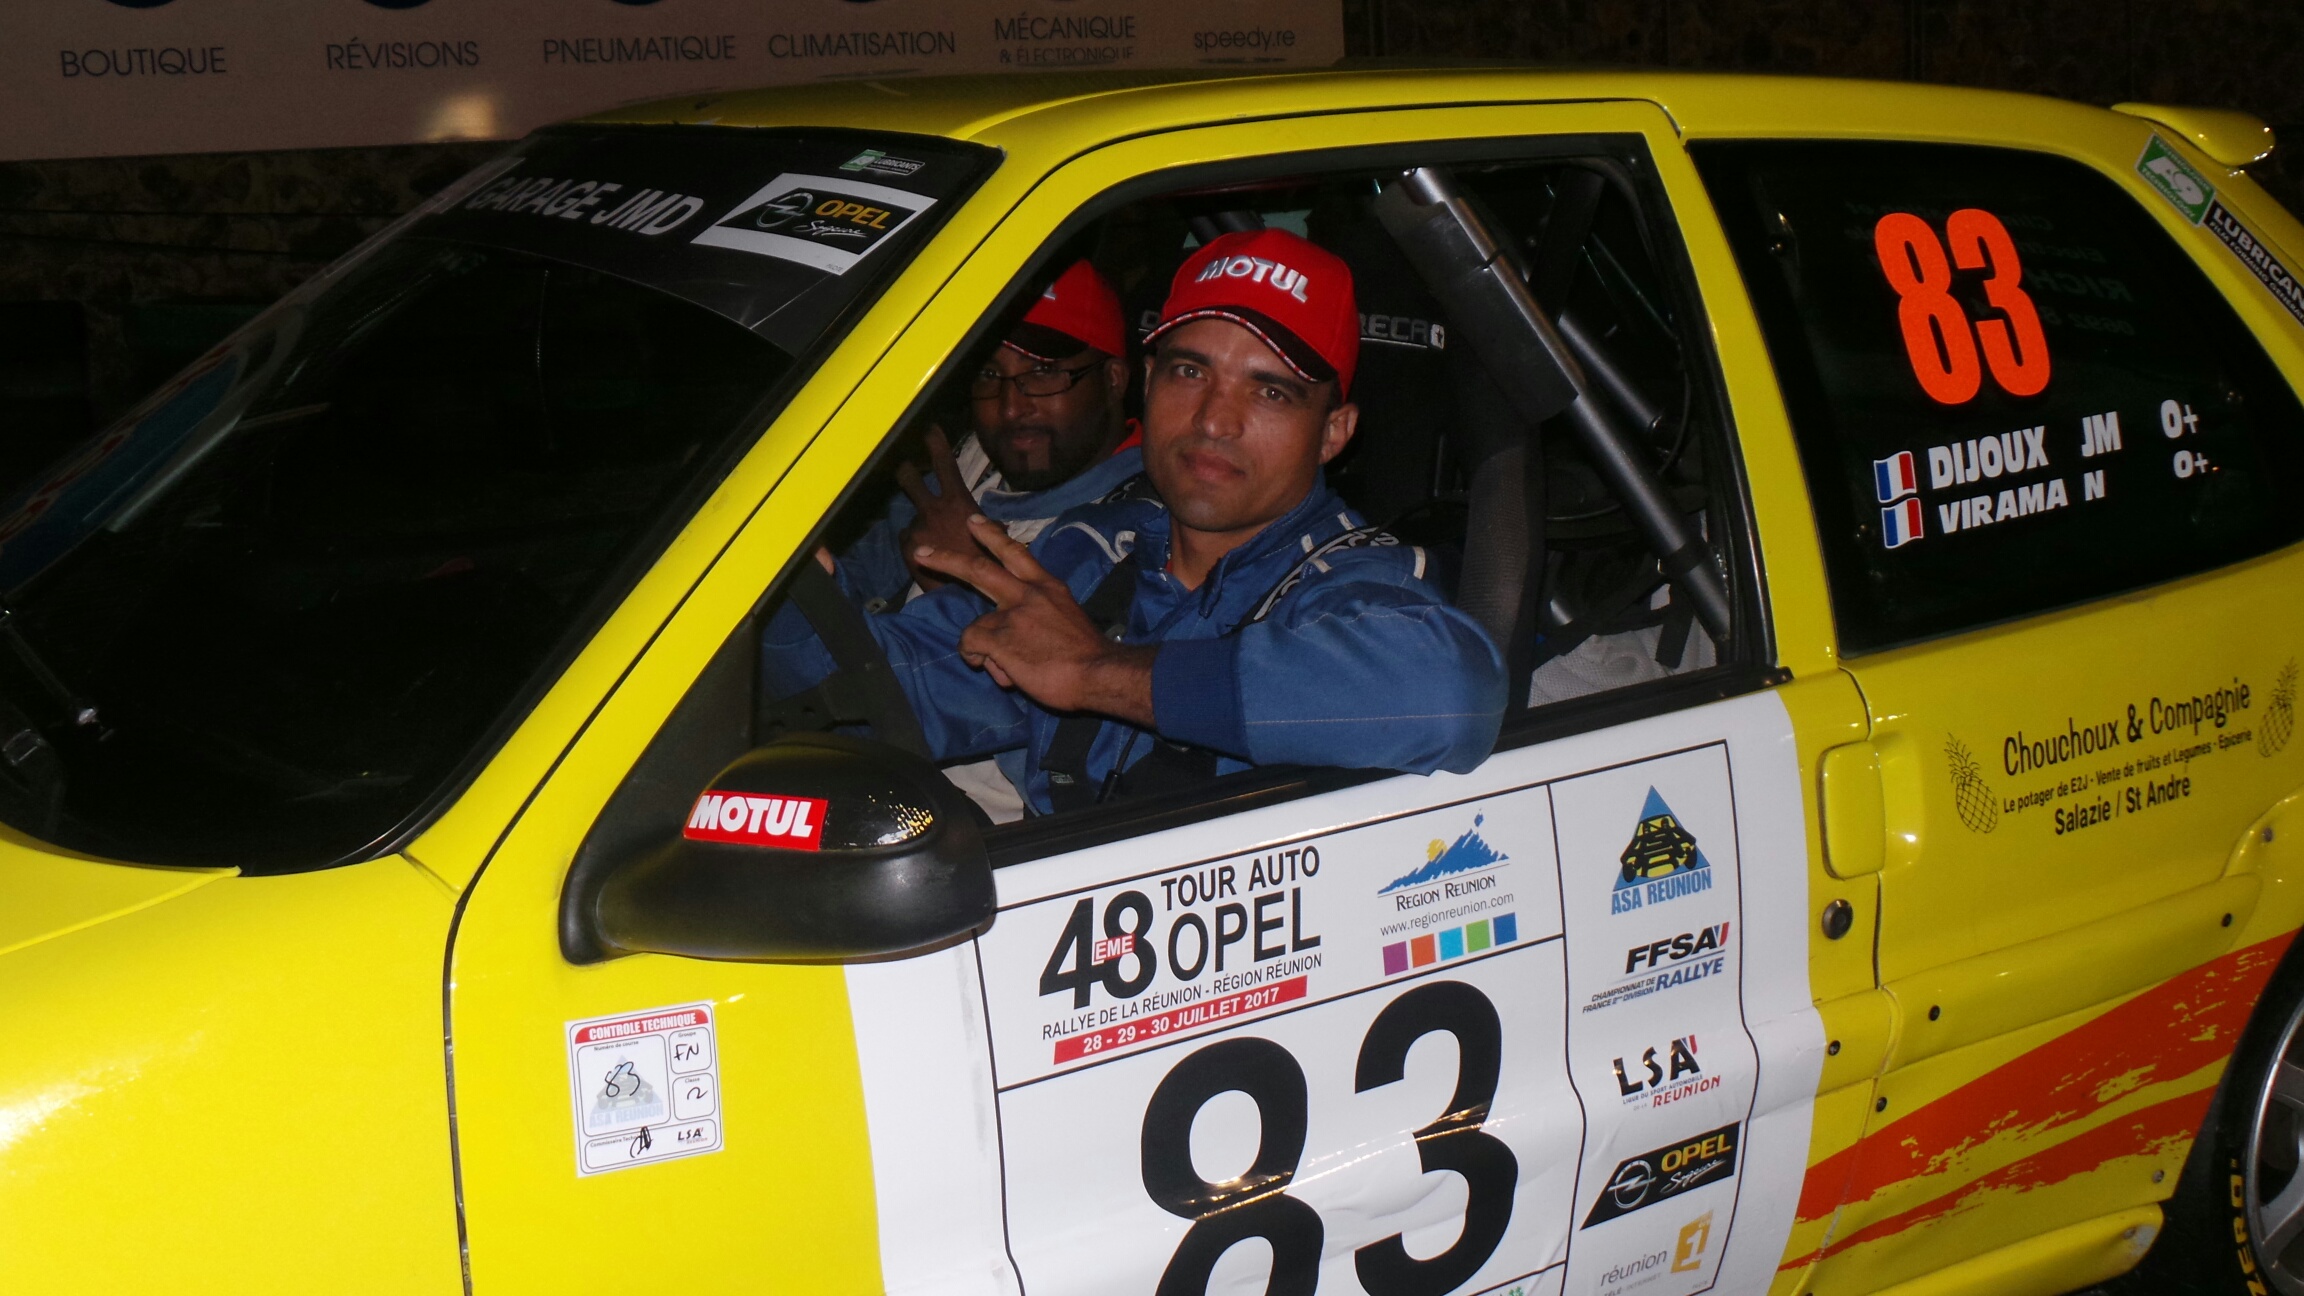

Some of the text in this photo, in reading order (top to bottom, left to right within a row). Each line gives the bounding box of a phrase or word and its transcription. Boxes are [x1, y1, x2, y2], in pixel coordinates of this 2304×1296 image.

[768, 31, 956, 58] CLIMATISATION
[994, 12, 1136, 41] MÉCANIQUE
[1194, 27, 1296, 52] speedy.re
[60, 47, 227, 77] BOUTIQUE
[326, 37, 480, 70] RÉVISIONS
[542, 35, 737, 65] PNEUMATIQUE
[466, 176, 705, 236] GARAGE JMD
[814, 199, 892, 229] OPEL
[1194, 254, 1309, 304] MOTUL
[1874, 208, 2051, 404] 83
[1928, 425, 2050, 489] DIJOUX
[2081, 411, 2122, 457] JM
[1938, 479, 2069, 533] VIRAMA
[2084, 470, 2106, 502] N
[2003, 677, 2251, 776] Chouchoux & Compagnie
[2003, 797, 2017, 814] Le
[2017, 785, 2055, 814] potager
[2057, 780, 2069, 797] de
[2095, 767, 2122, 787] Vente
[2123, 762, 2134, 778] de
[2136, 755, 2162, 775] fruits
[2163, 752, 2172, 768] et
[688, 795, 813, 838] MOTUL
[2054, 799, 2111, 835] Salazie
[2126, 786, 2142, 814] St
[1160, 845, 1320, 912] TOUR AUTO
[1611, 868, 1713, 915] ASA REUNION
[1167, 886, 1322, 982] OPEL
[1380, 892, 1514, 937] www.regionreunion.com
[1038, 890, 1157, 1010] 48 EME
[1625, 926, 1718, 974] FFSA
[1591, 977, 1656, 1003] CHAMPIONNAT DE
[1655, 956, 1724, 992] RALLYE
[1042, 1012, 1096, 1040] RALLYE
[1099, 1006, 1119, 1026] DE
[1121, 1002, 1139, 1020] LA
[1142, 983, 1202, 1015] RÉUNION
[1212, 968, 1263, 996] RÉGION
[1265, 952, 1323, 985] RÉUNION
[1582, 998, 1611, 1014] FRANCE
[1623, 986, 1655, 1003] DIVISION
[588, 1012, 697, 1041] CONTROLE TECHNIQUE
[1083, 1034, 1103, 1054] 28
[1117, 1025, 1136, 1046] 29
[1151, 1017, 1169, 1036] 30
[1173, 997, 1241, 1032] JUILLET
[1244, 987, 1280, 1013] 2017
[674, 1042, 699, 1061] FN
[1612, 1038, 1701, 1097] LSA
[604, 1061, 641, 1098] 83
[1640, 1091, 1649, 1099] DU
[1650, 1085, 1668, 1096] SPORT
[1668, 1074, 1703, 1090] AUTOMOBILE
[1653, 1075, 1721, 1108] REUNION
[589, 1112, 612, 1128] ASA
[678, 1127, 702, 1142] LSA
[1141, 980, 1519, 1296] 83
[1661, 1133, 1732, 1173] OPEL
[1601, 1250, 1668, 1286] réunion
